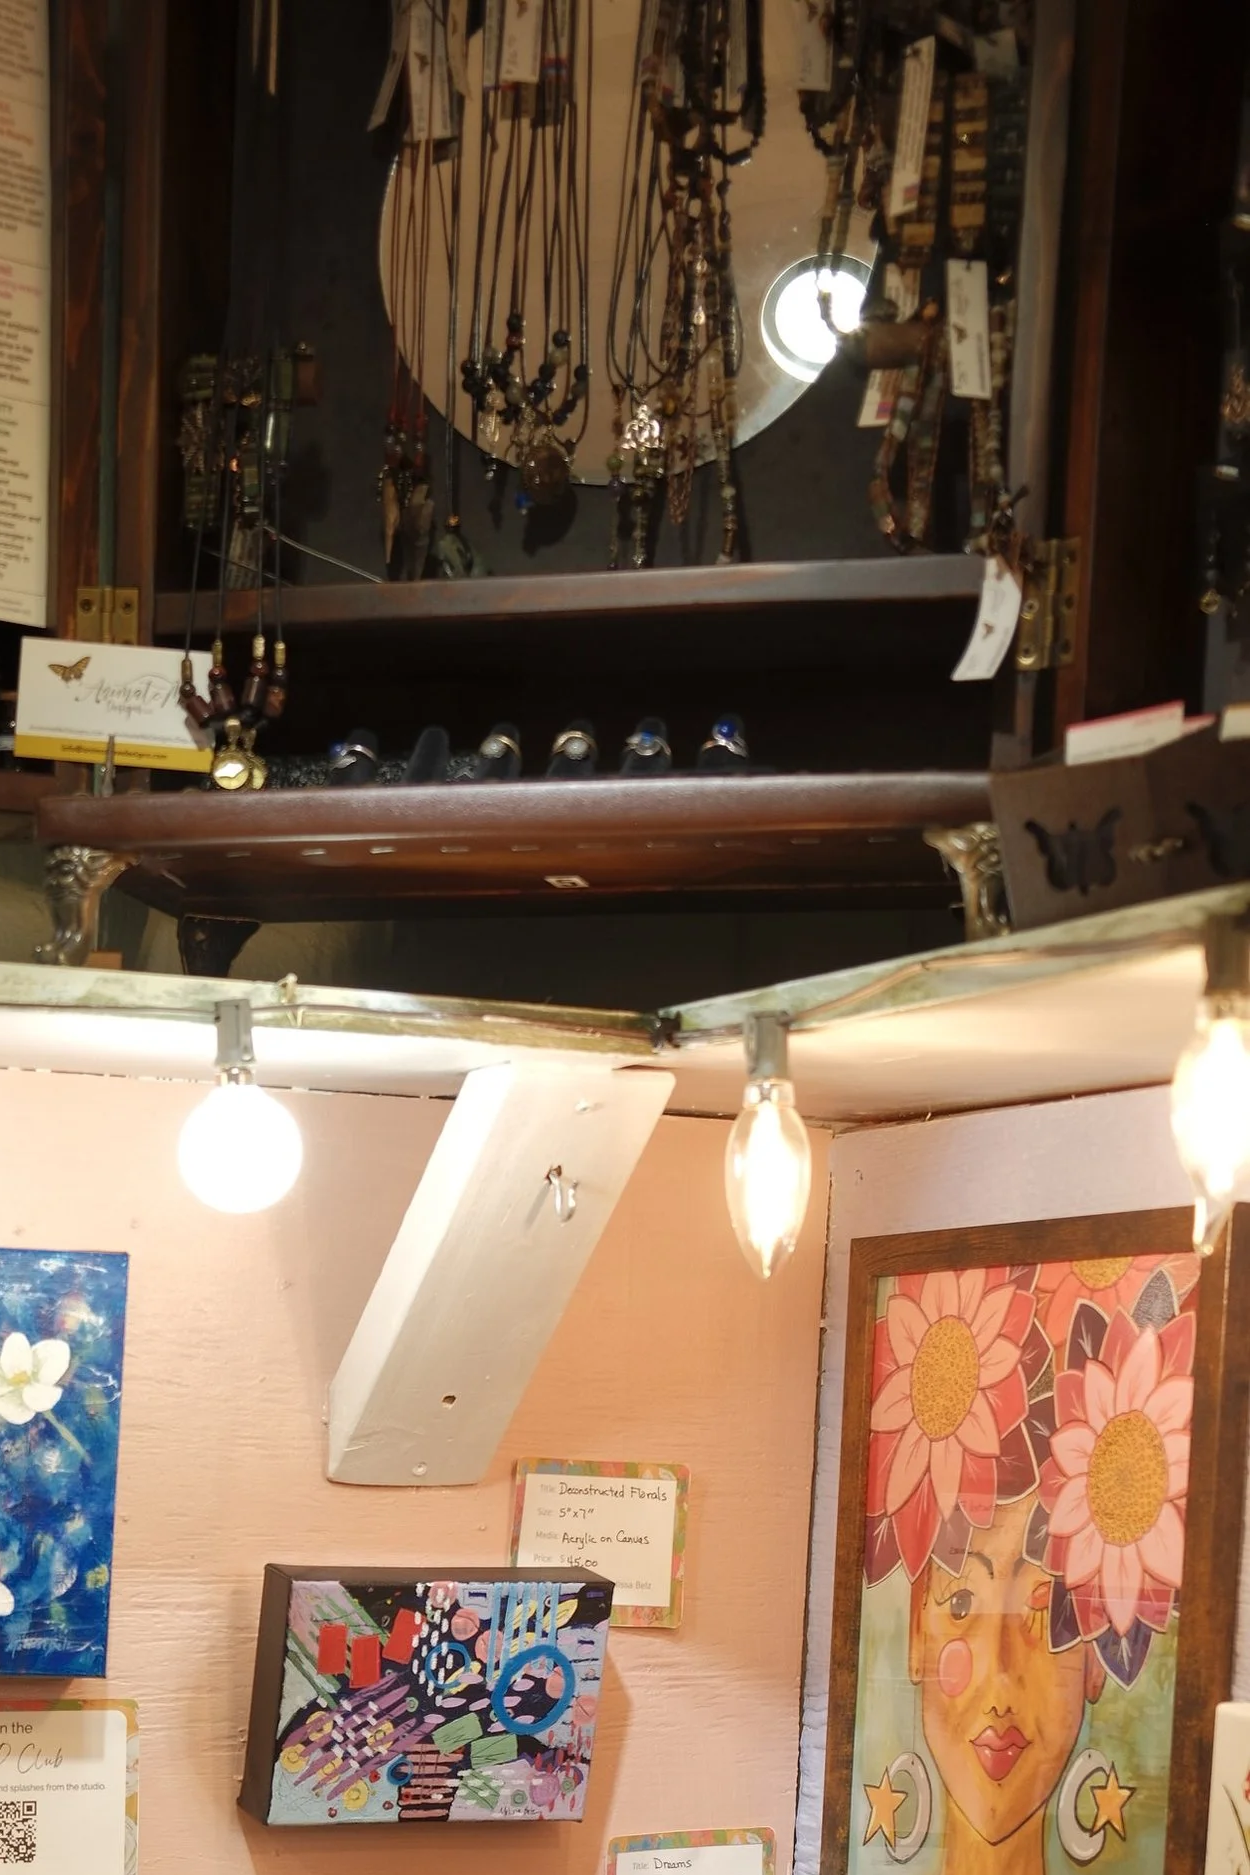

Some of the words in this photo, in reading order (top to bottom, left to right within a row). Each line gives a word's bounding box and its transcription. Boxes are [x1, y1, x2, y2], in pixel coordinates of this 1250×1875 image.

[559, 1482, 624, 1498] Deconstructed
[630, 1486, 667, 1501] Florals
[562, 1532, 597, 1549] Acrylic
[616, 1530, 650, 1545] Canvas
[12, 1722, 33, 1734] the
[17, 1743, 63, 1774] Club
[10, 1783, 44, 1793] splashes
[44, 1782, 65, 1791] from
[66, 1782, 79, 1791] the
[654, 1858, 692, 1869] Dreams
